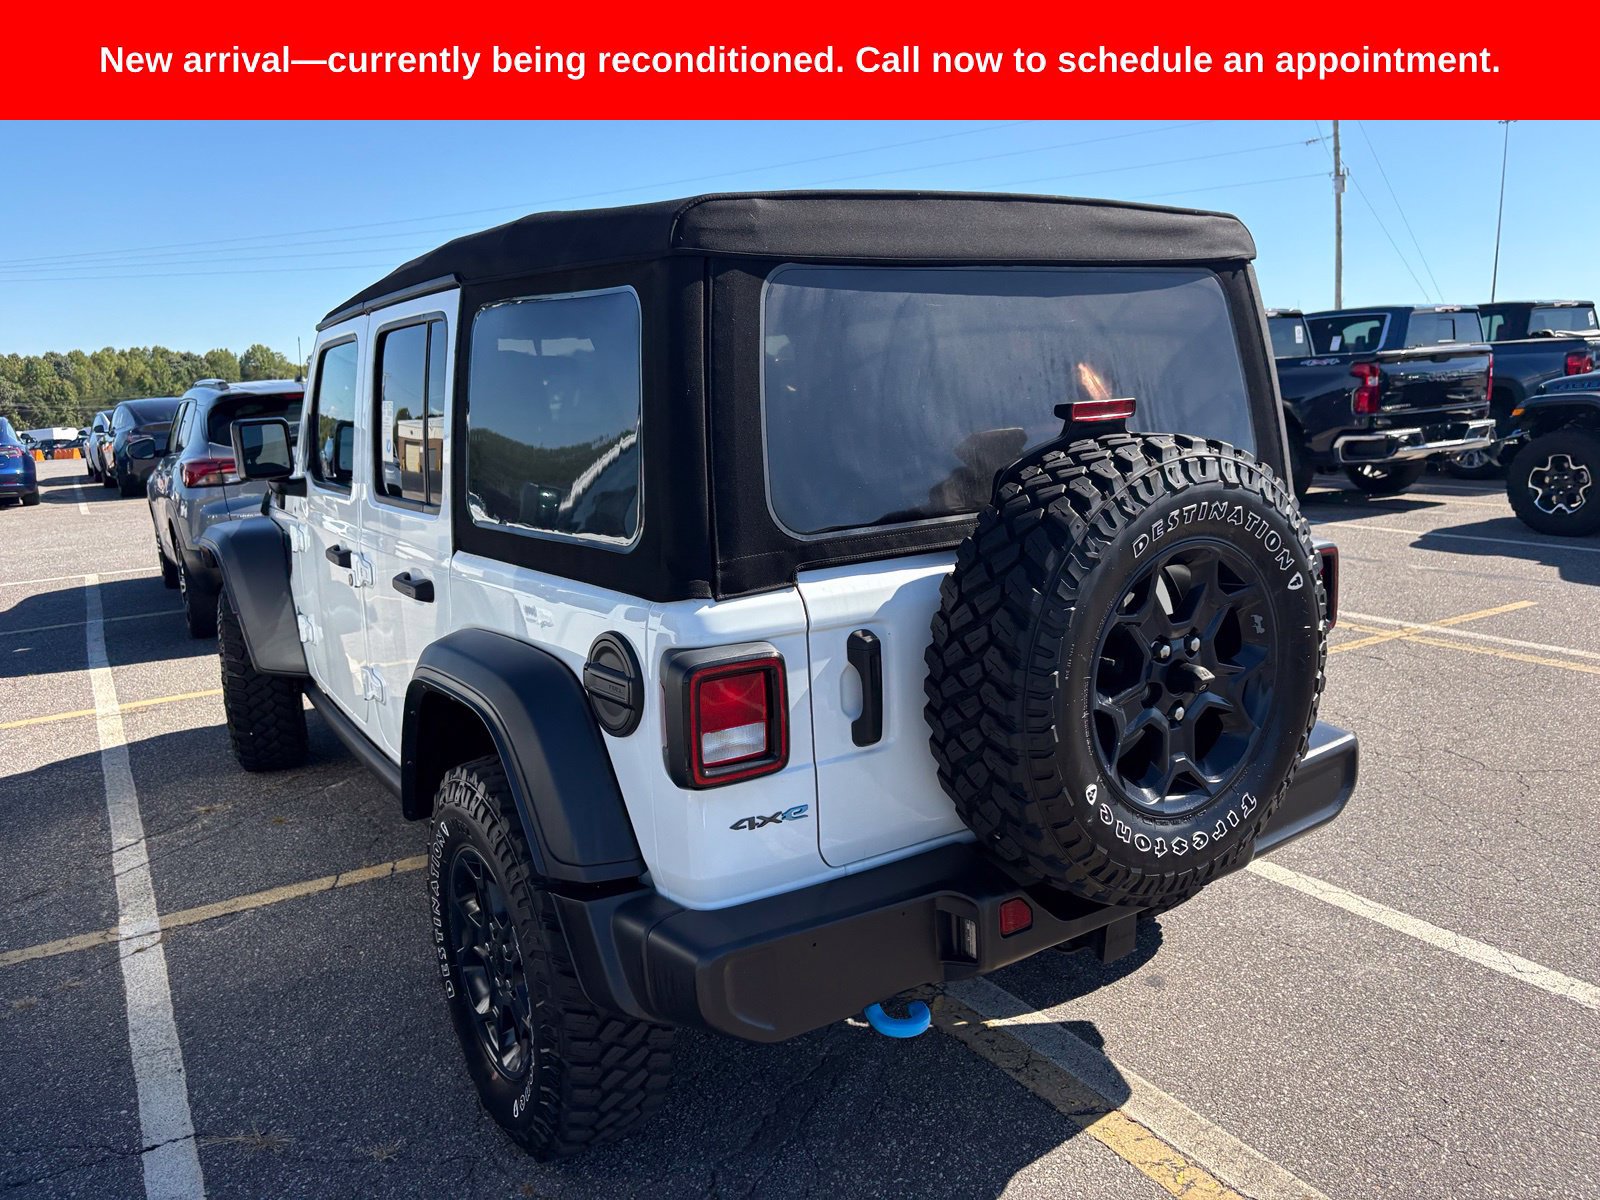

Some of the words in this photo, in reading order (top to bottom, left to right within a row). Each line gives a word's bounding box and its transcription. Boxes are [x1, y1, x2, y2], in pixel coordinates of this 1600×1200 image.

[1131, 500, 1295, 571] DESTINATION
[1099, 792, 1257, 858] Firestone
[430, 829, 455, 999] DESTINATION
